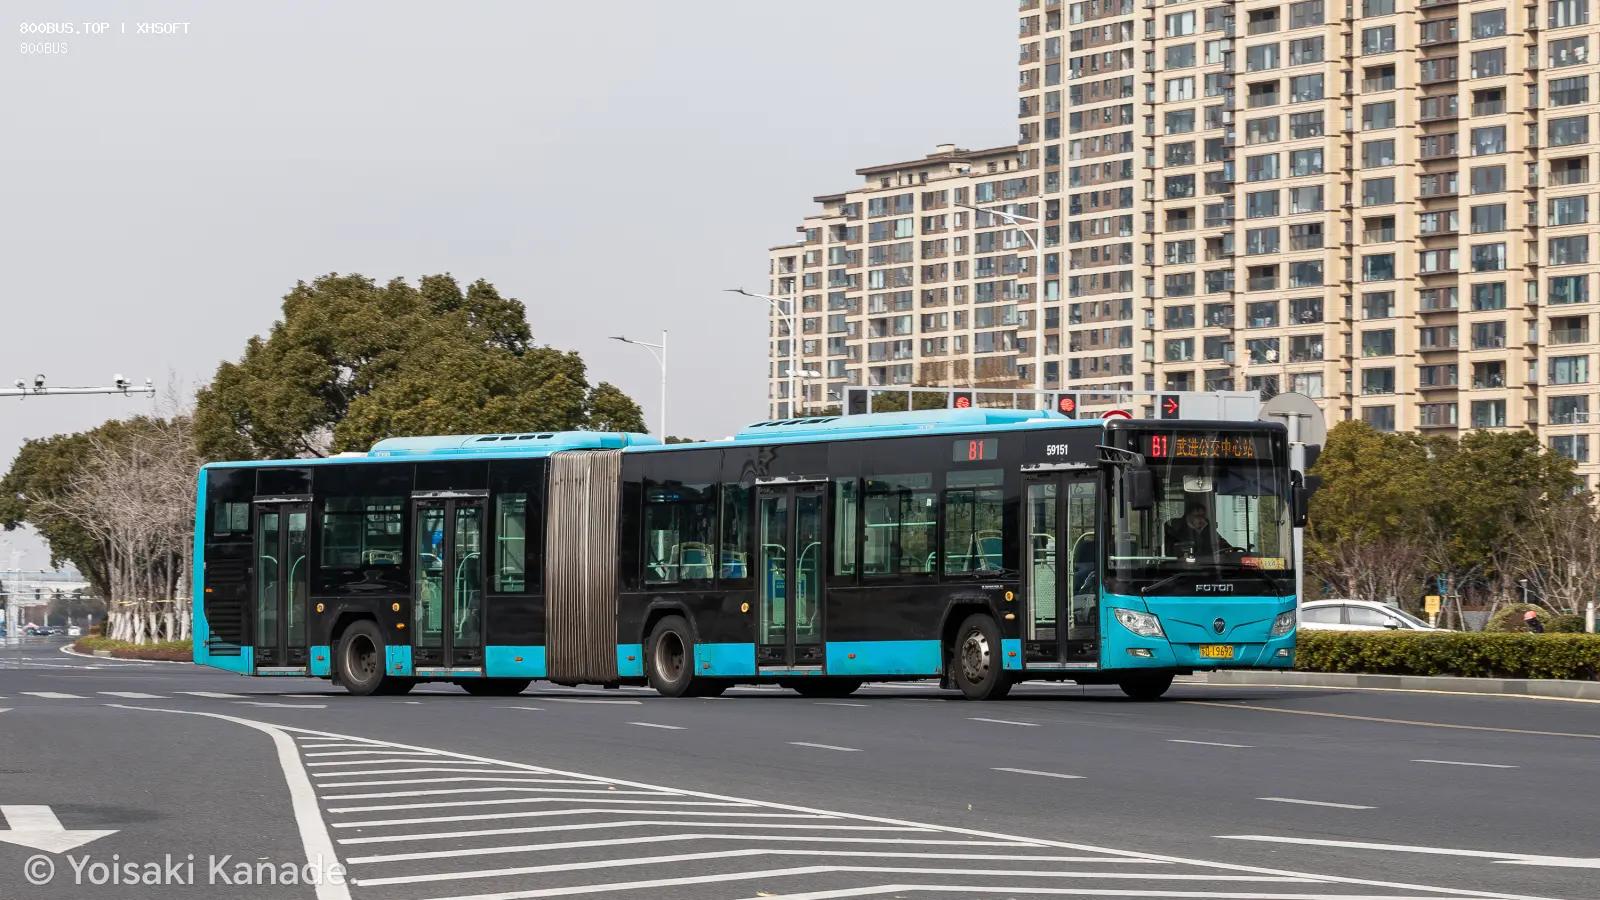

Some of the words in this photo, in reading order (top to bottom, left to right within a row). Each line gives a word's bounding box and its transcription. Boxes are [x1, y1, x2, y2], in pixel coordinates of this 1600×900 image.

[968, 440, 984, 461] B1
[1046, 444, 1068, 456] 59151
[1152, 435, 1167, 458] B1
[1176, 437, 1253, 458] 武进公交中心站
[1195, 583, 1234, 592] FOTON
